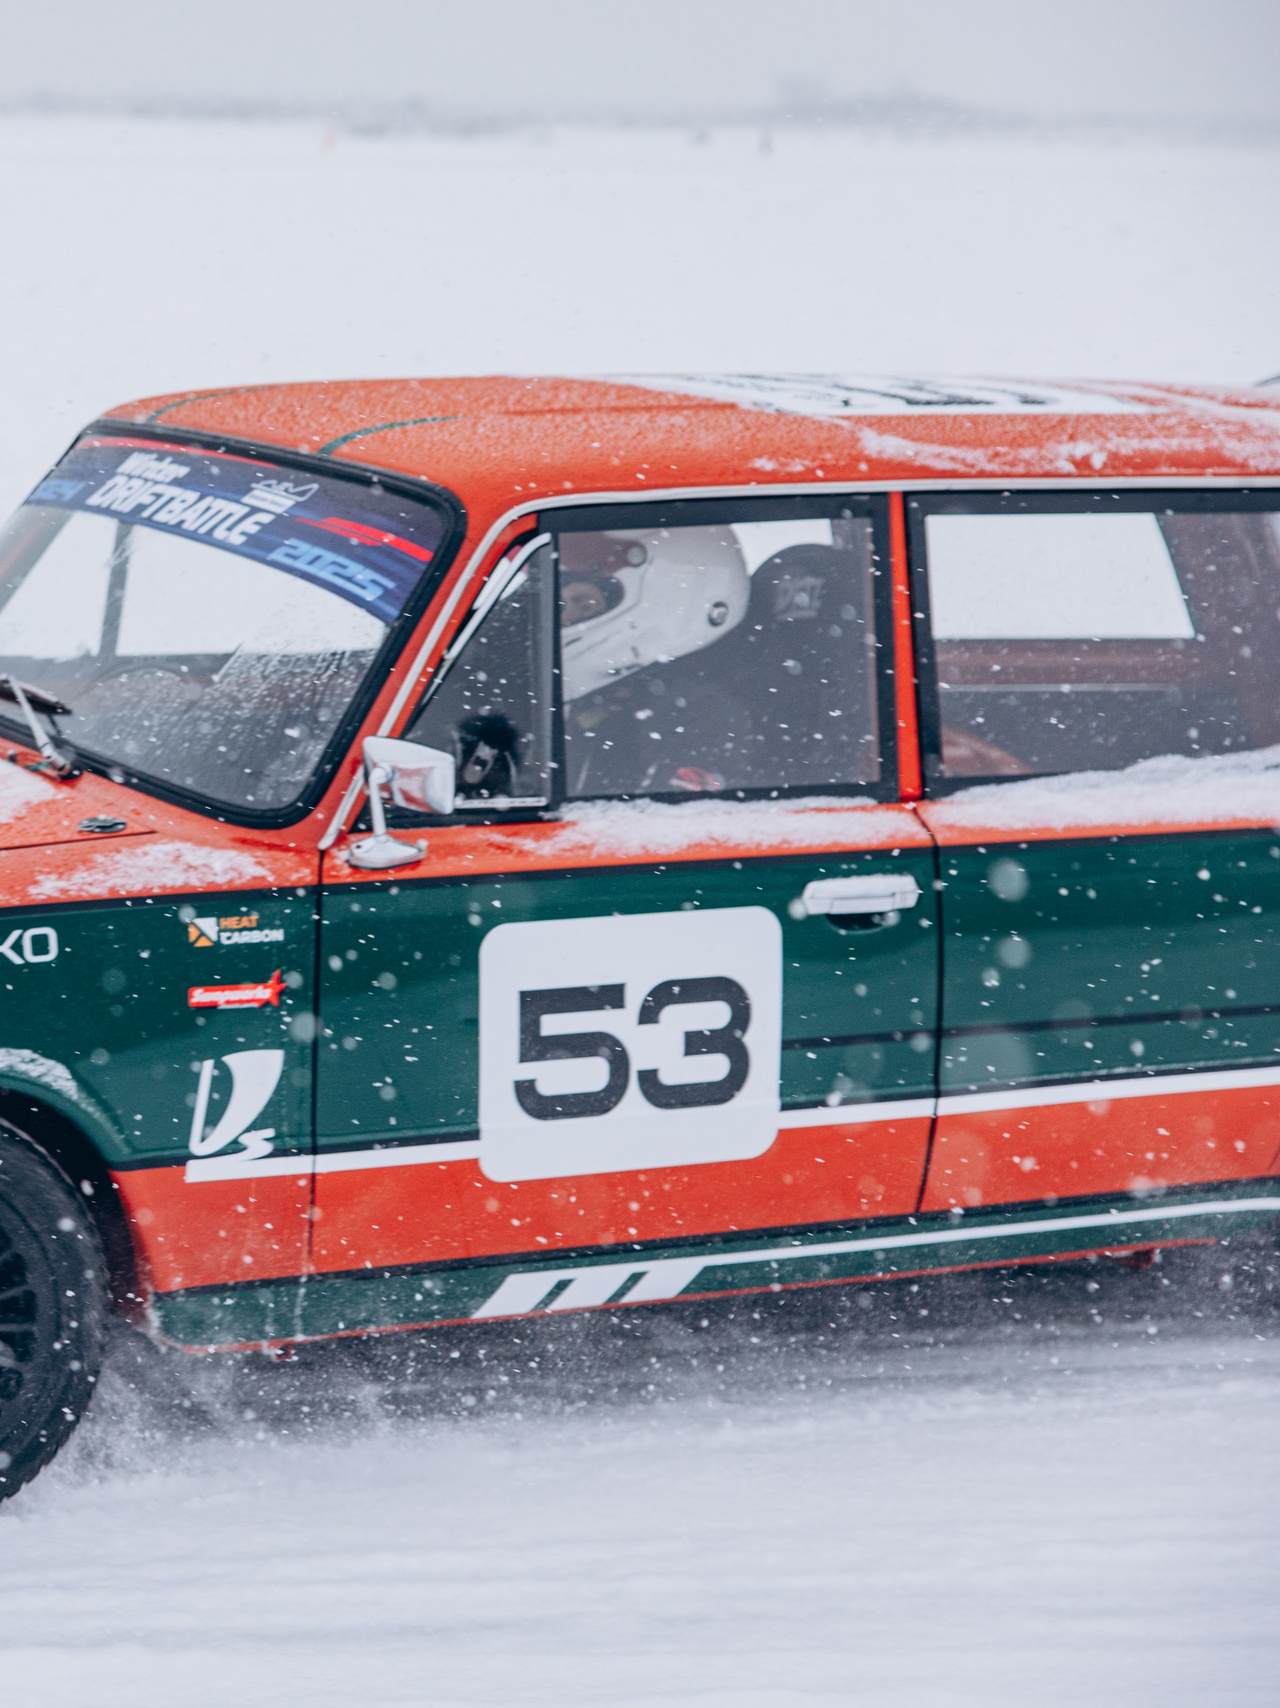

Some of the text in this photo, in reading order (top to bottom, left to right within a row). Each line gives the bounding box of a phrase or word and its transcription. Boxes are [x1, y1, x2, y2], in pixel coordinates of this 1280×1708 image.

[116, 451, 190, 483] Winter
[267, 538, 396, 601] 2025
[219, 915, 260, 929] HEAT
[220, 928, 284, 945] CARBON
[513, 975, 752, 1121] 53
